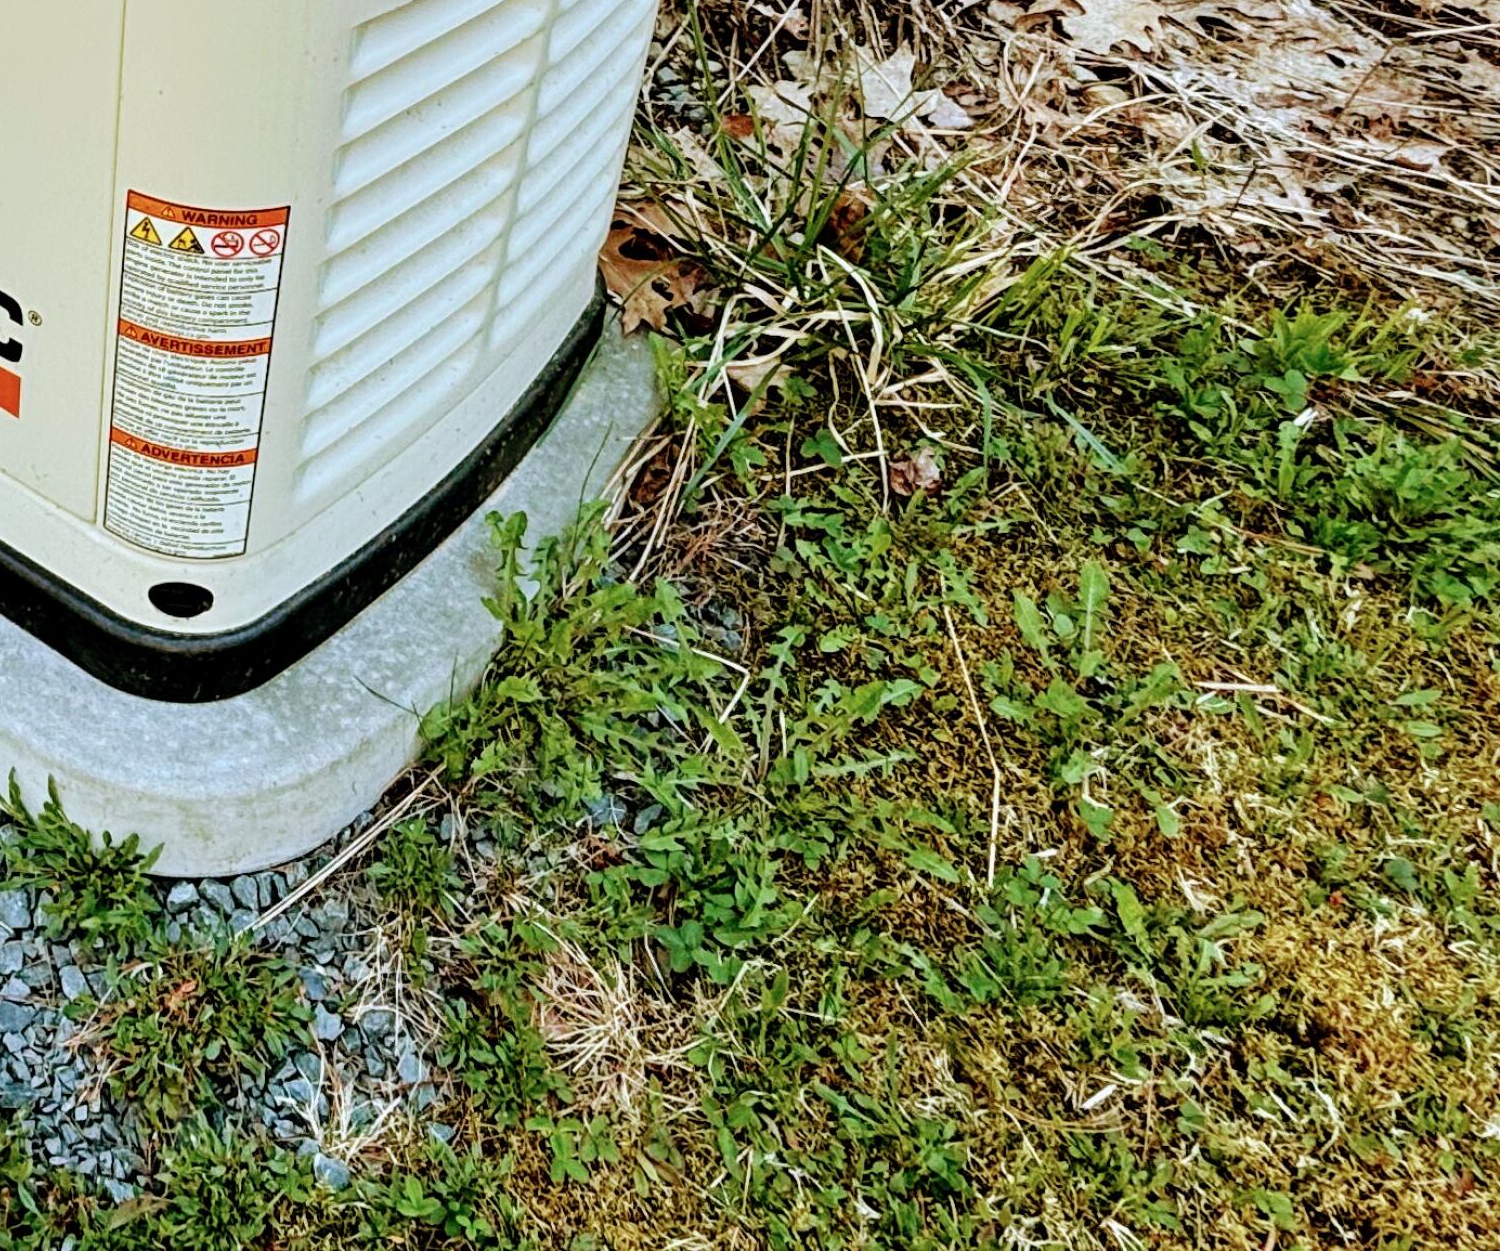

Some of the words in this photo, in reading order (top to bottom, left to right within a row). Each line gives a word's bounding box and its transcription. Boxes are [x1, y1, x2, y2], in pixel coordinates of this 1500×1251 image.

[182, 209, 258, 226] WARNING
[141, 332, 267, 356] AVERTISSEMENT
[141, 443, 245, 465] ADVERTENCIA
